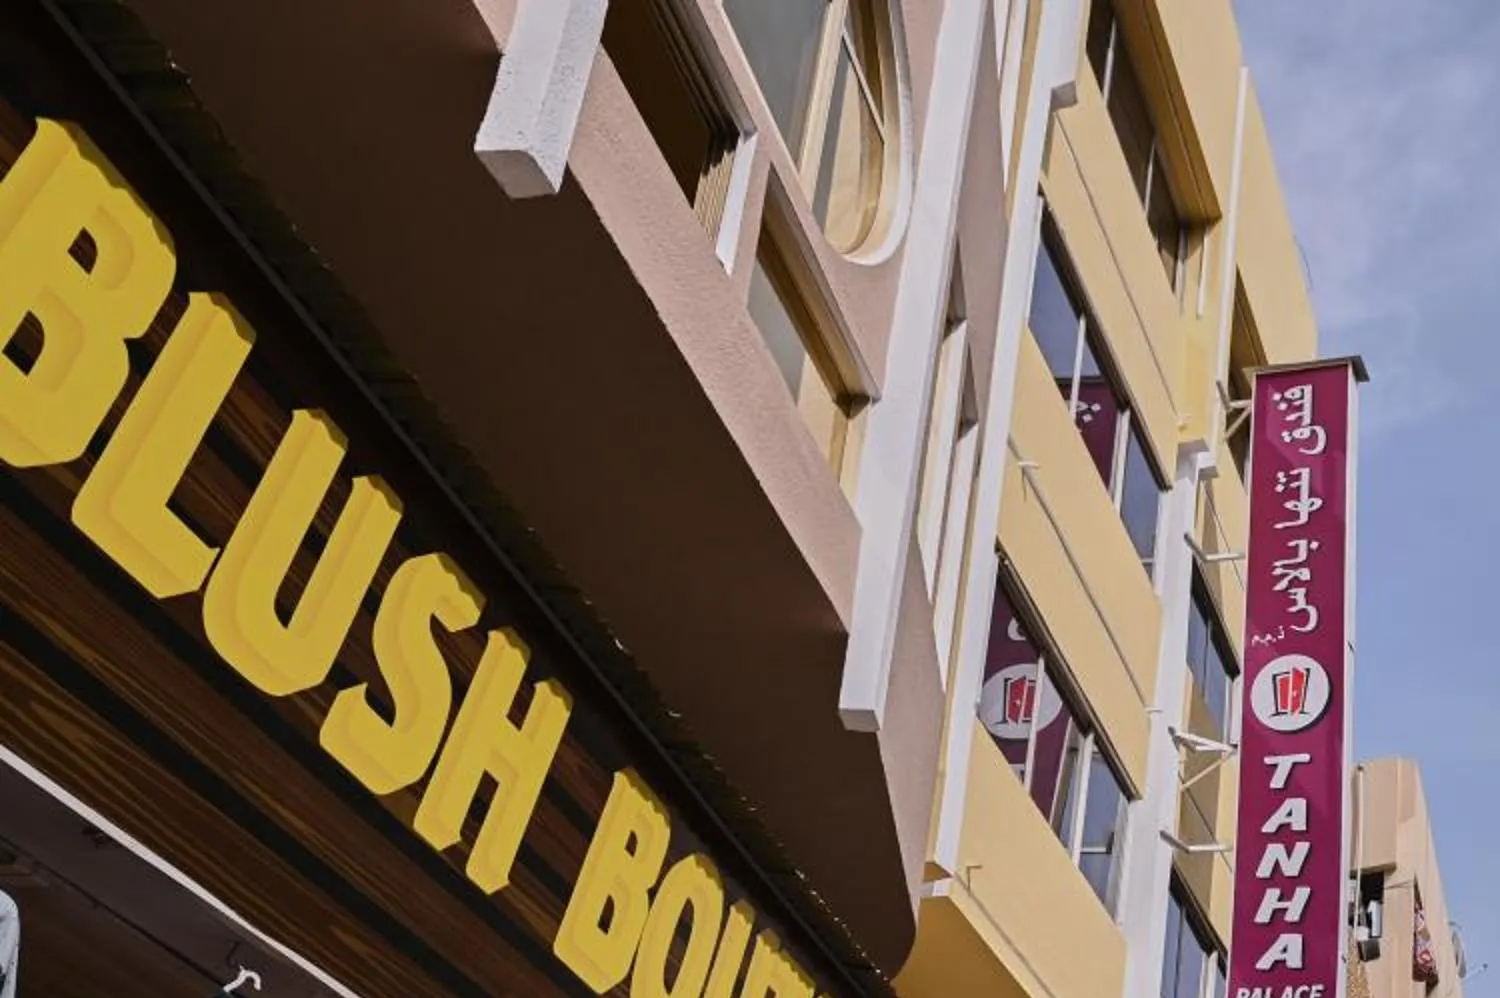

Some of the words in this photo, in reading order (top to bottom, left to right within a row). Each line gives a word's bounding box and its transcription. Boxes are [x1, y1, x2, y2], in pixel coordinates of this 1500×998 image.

[0, 115, 574, 895] BLUSH
[1272, 384, 1327, 455] فندق
[1255, 753, 1311, 971] TANHA
